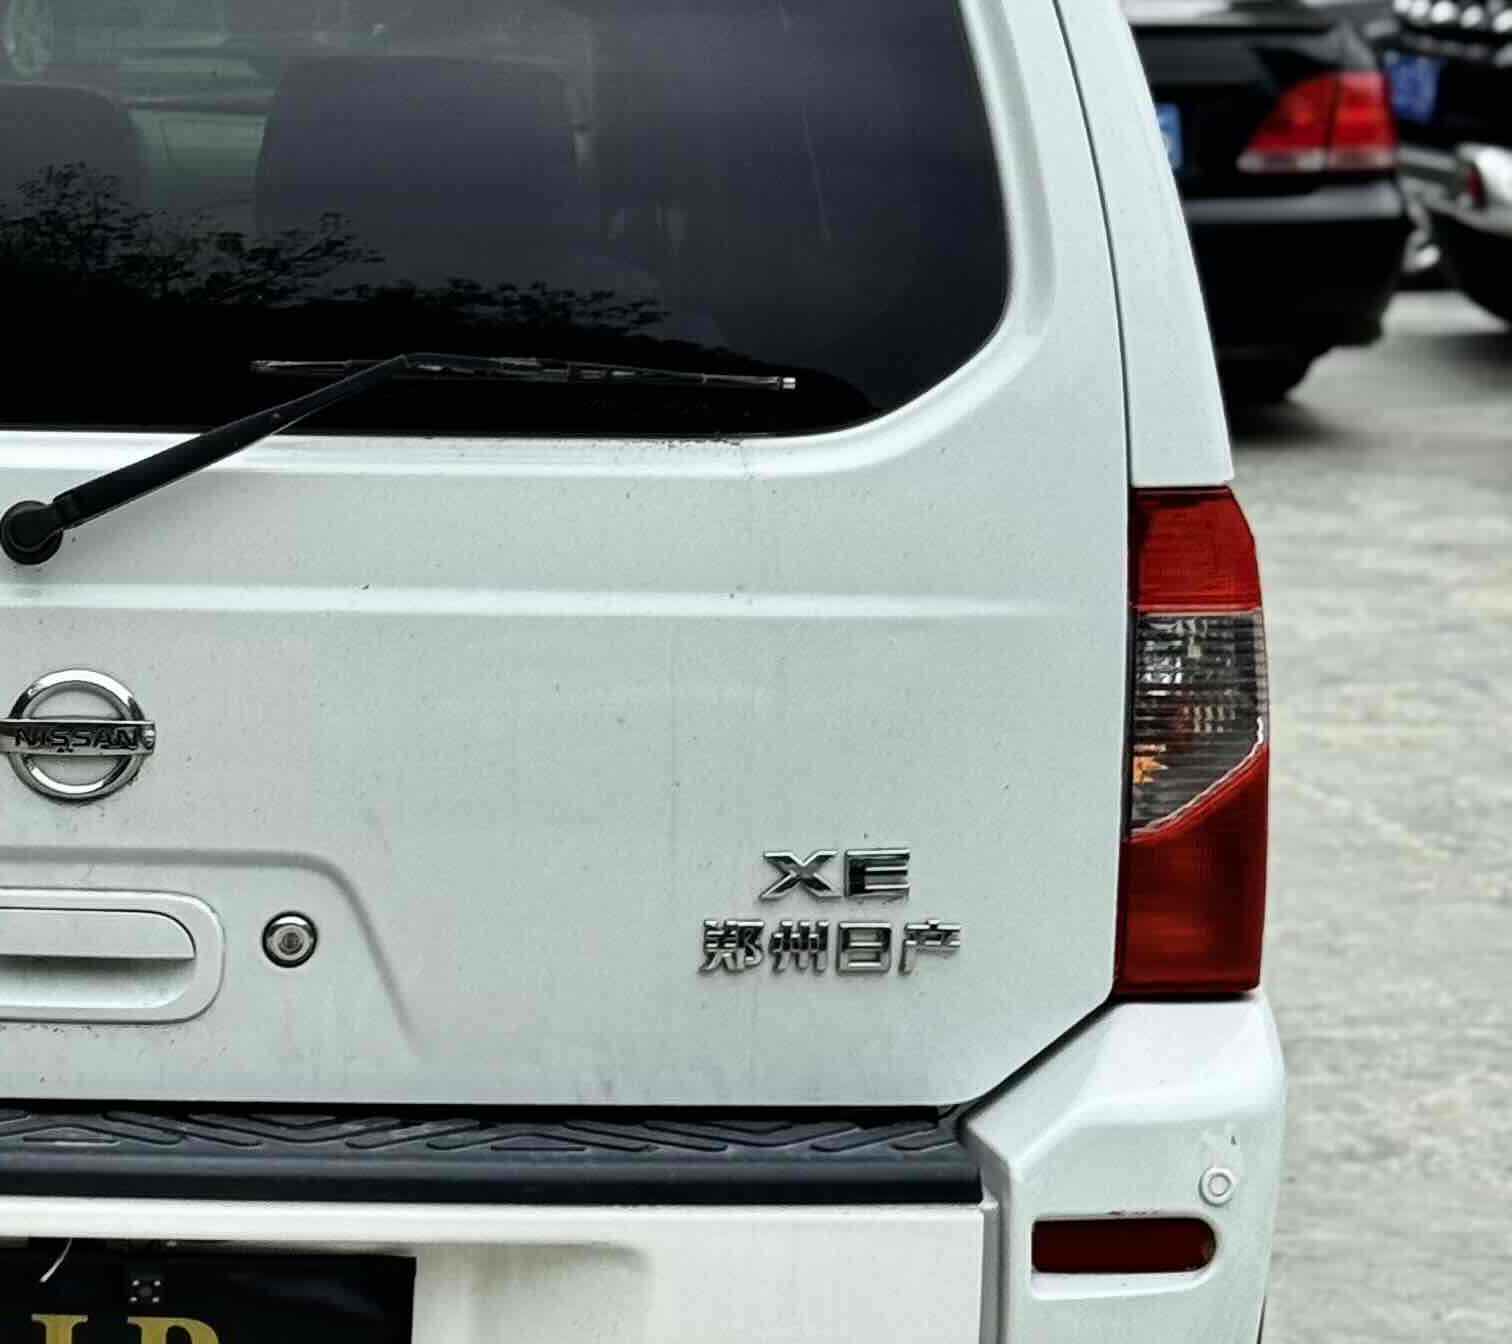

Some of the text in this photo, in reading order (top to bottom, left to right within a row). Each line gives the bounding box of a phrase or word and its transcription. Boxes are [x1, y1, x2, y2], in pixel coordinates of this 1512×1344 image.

[13, 727, 138, 750] NISSAN
[759, 848, 911, 901] XE
[697, 917, 961, 975] 郑州日产
